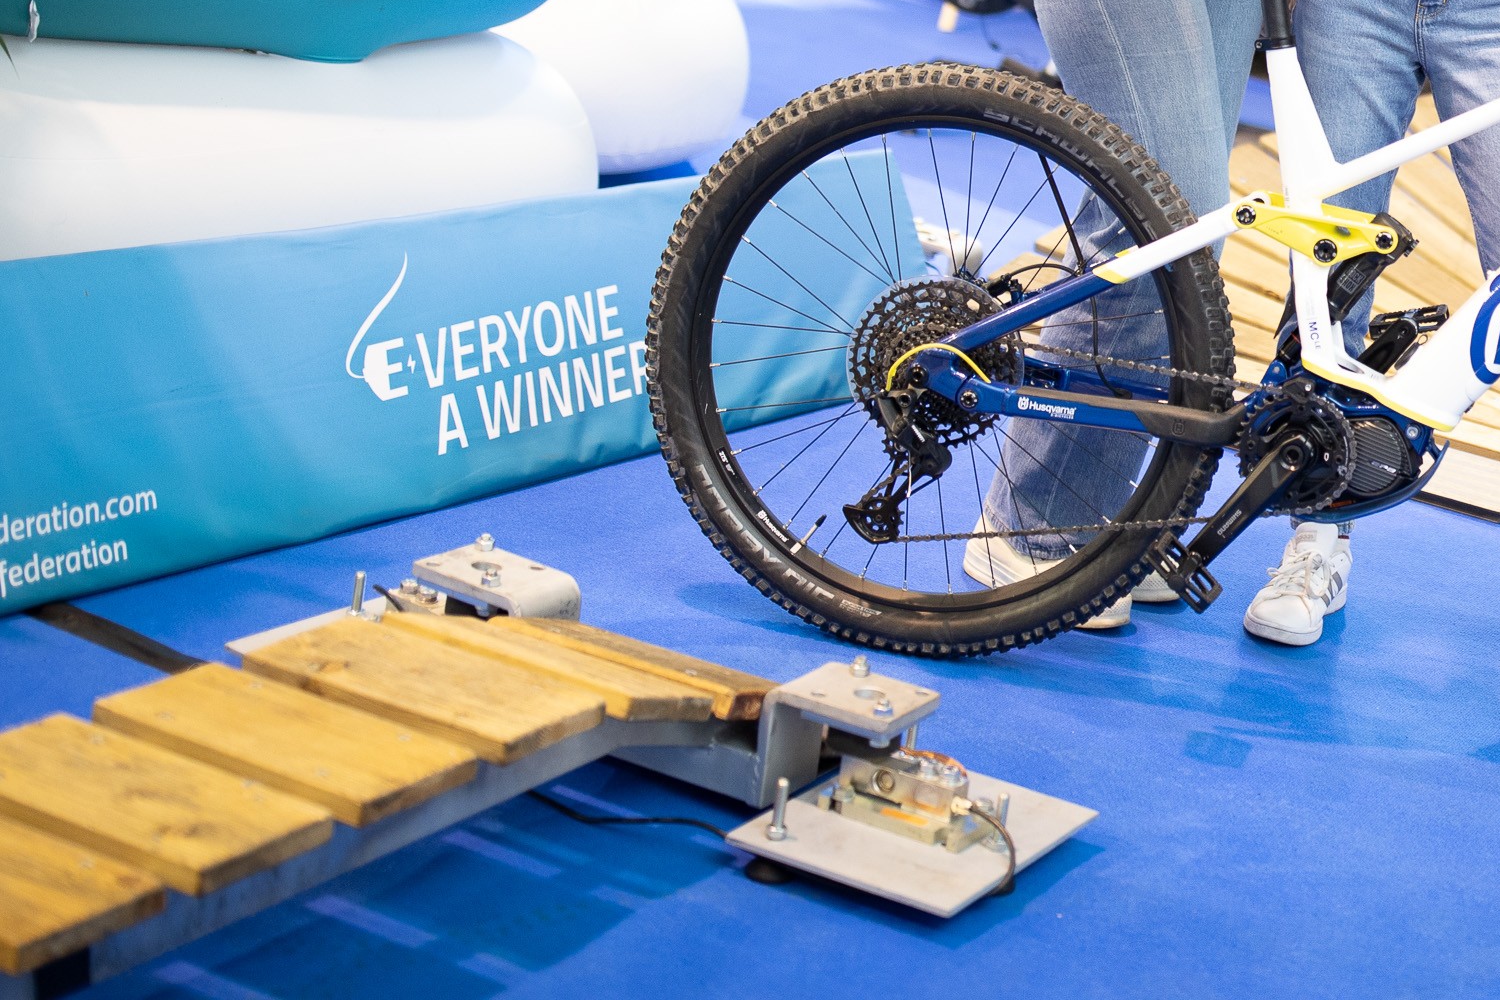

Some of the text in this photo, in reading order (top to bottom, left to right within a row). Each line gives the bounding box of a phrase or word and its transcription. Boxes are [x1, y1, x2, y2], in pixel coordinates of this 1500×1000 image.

[438, 339, 650, 456] A WINNER
[1028, 401, 1077, 416] Husqvarna
[0, 539, 129, 599] federation
